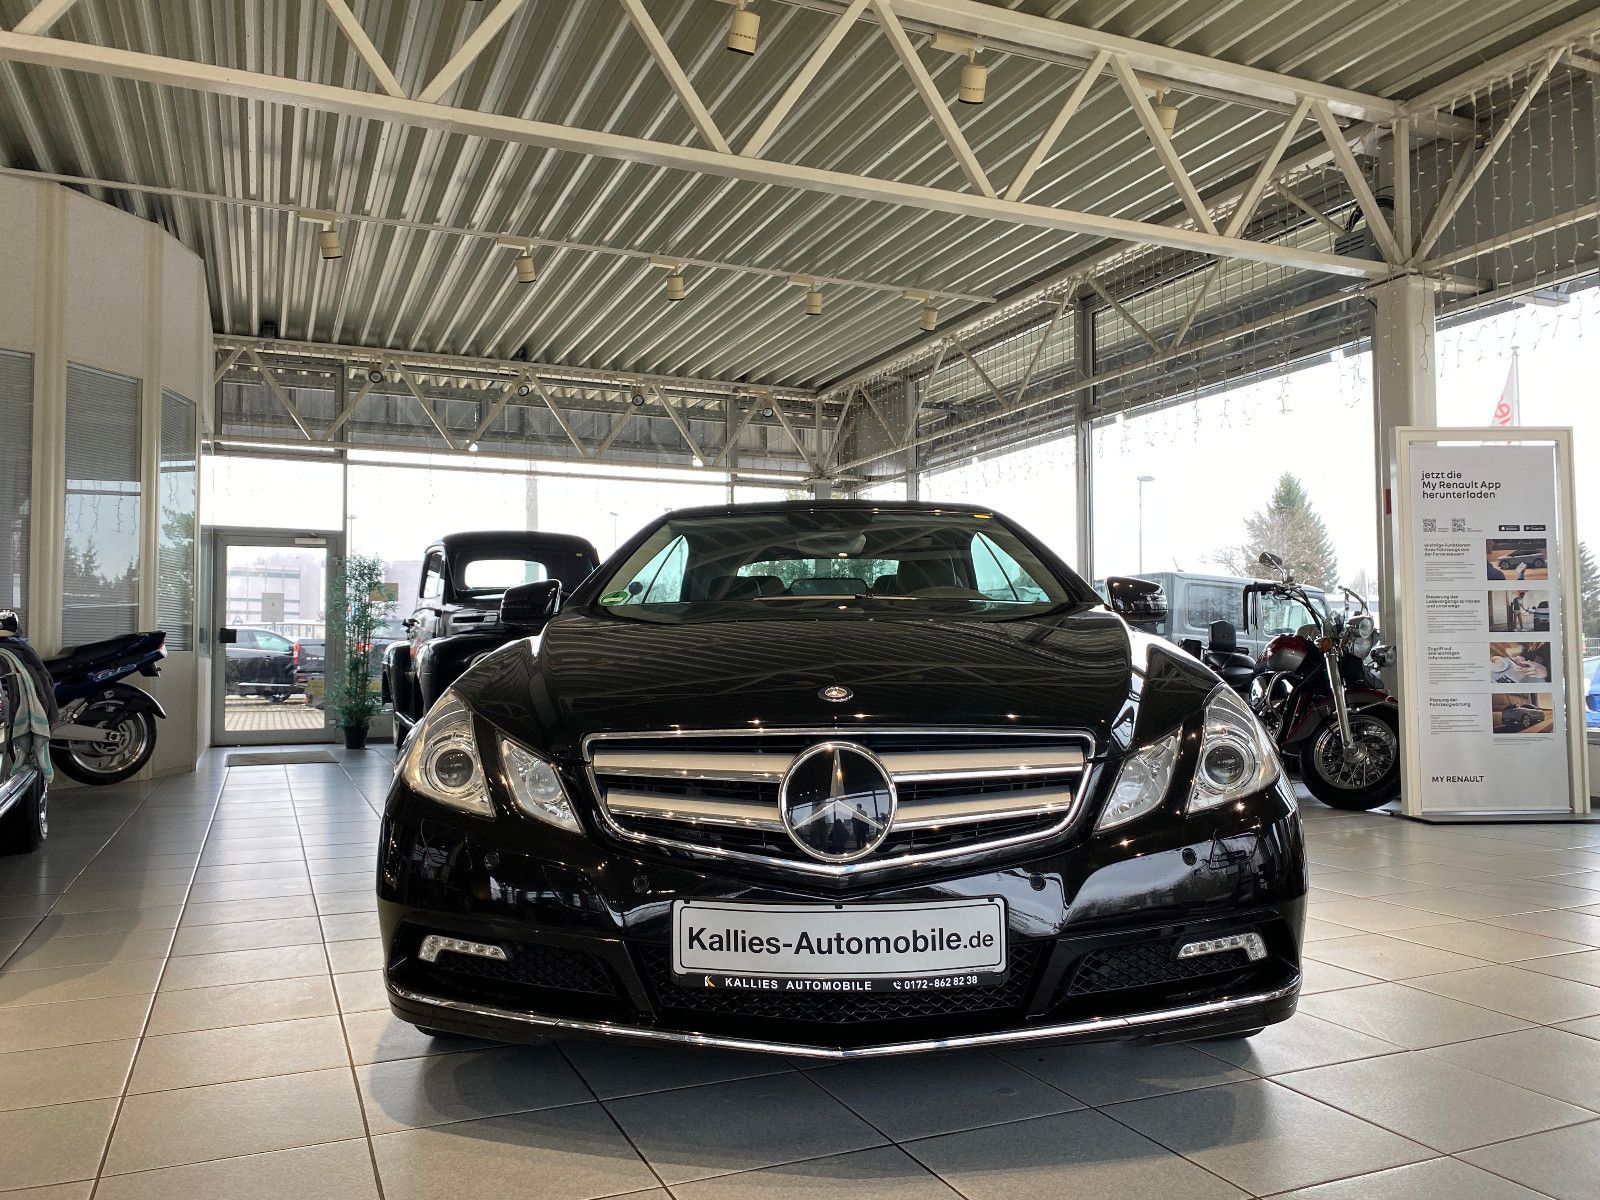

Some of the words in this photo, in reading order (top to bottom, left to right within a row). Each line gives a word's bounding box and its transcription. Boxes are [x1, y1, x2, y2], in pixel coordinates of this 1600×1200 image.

[1421, 471, 1445, 480] jetzt
[1446, 471, 1462, 479] die
[1422, 481, 1437, 490] My
[1439, 480, 1478, 489] Renault
[1480, 481, 1502, 490] App
[1422, 490, 1496, 499] herunterladen
[1431, 775, 1445, 783] MY
[1446, 775, 1485, 783] RENAULT
[688, 926, 994, 955] Kallies-Automobile.de
[725, 977, 778, 989] KALLIES
[786, 980, 872, 991] AUTOMOBILE
[904, 978, 951, 990] 0172-862
[953, 976, 965, 986] 82
[966, 975, 978, 985] 38
